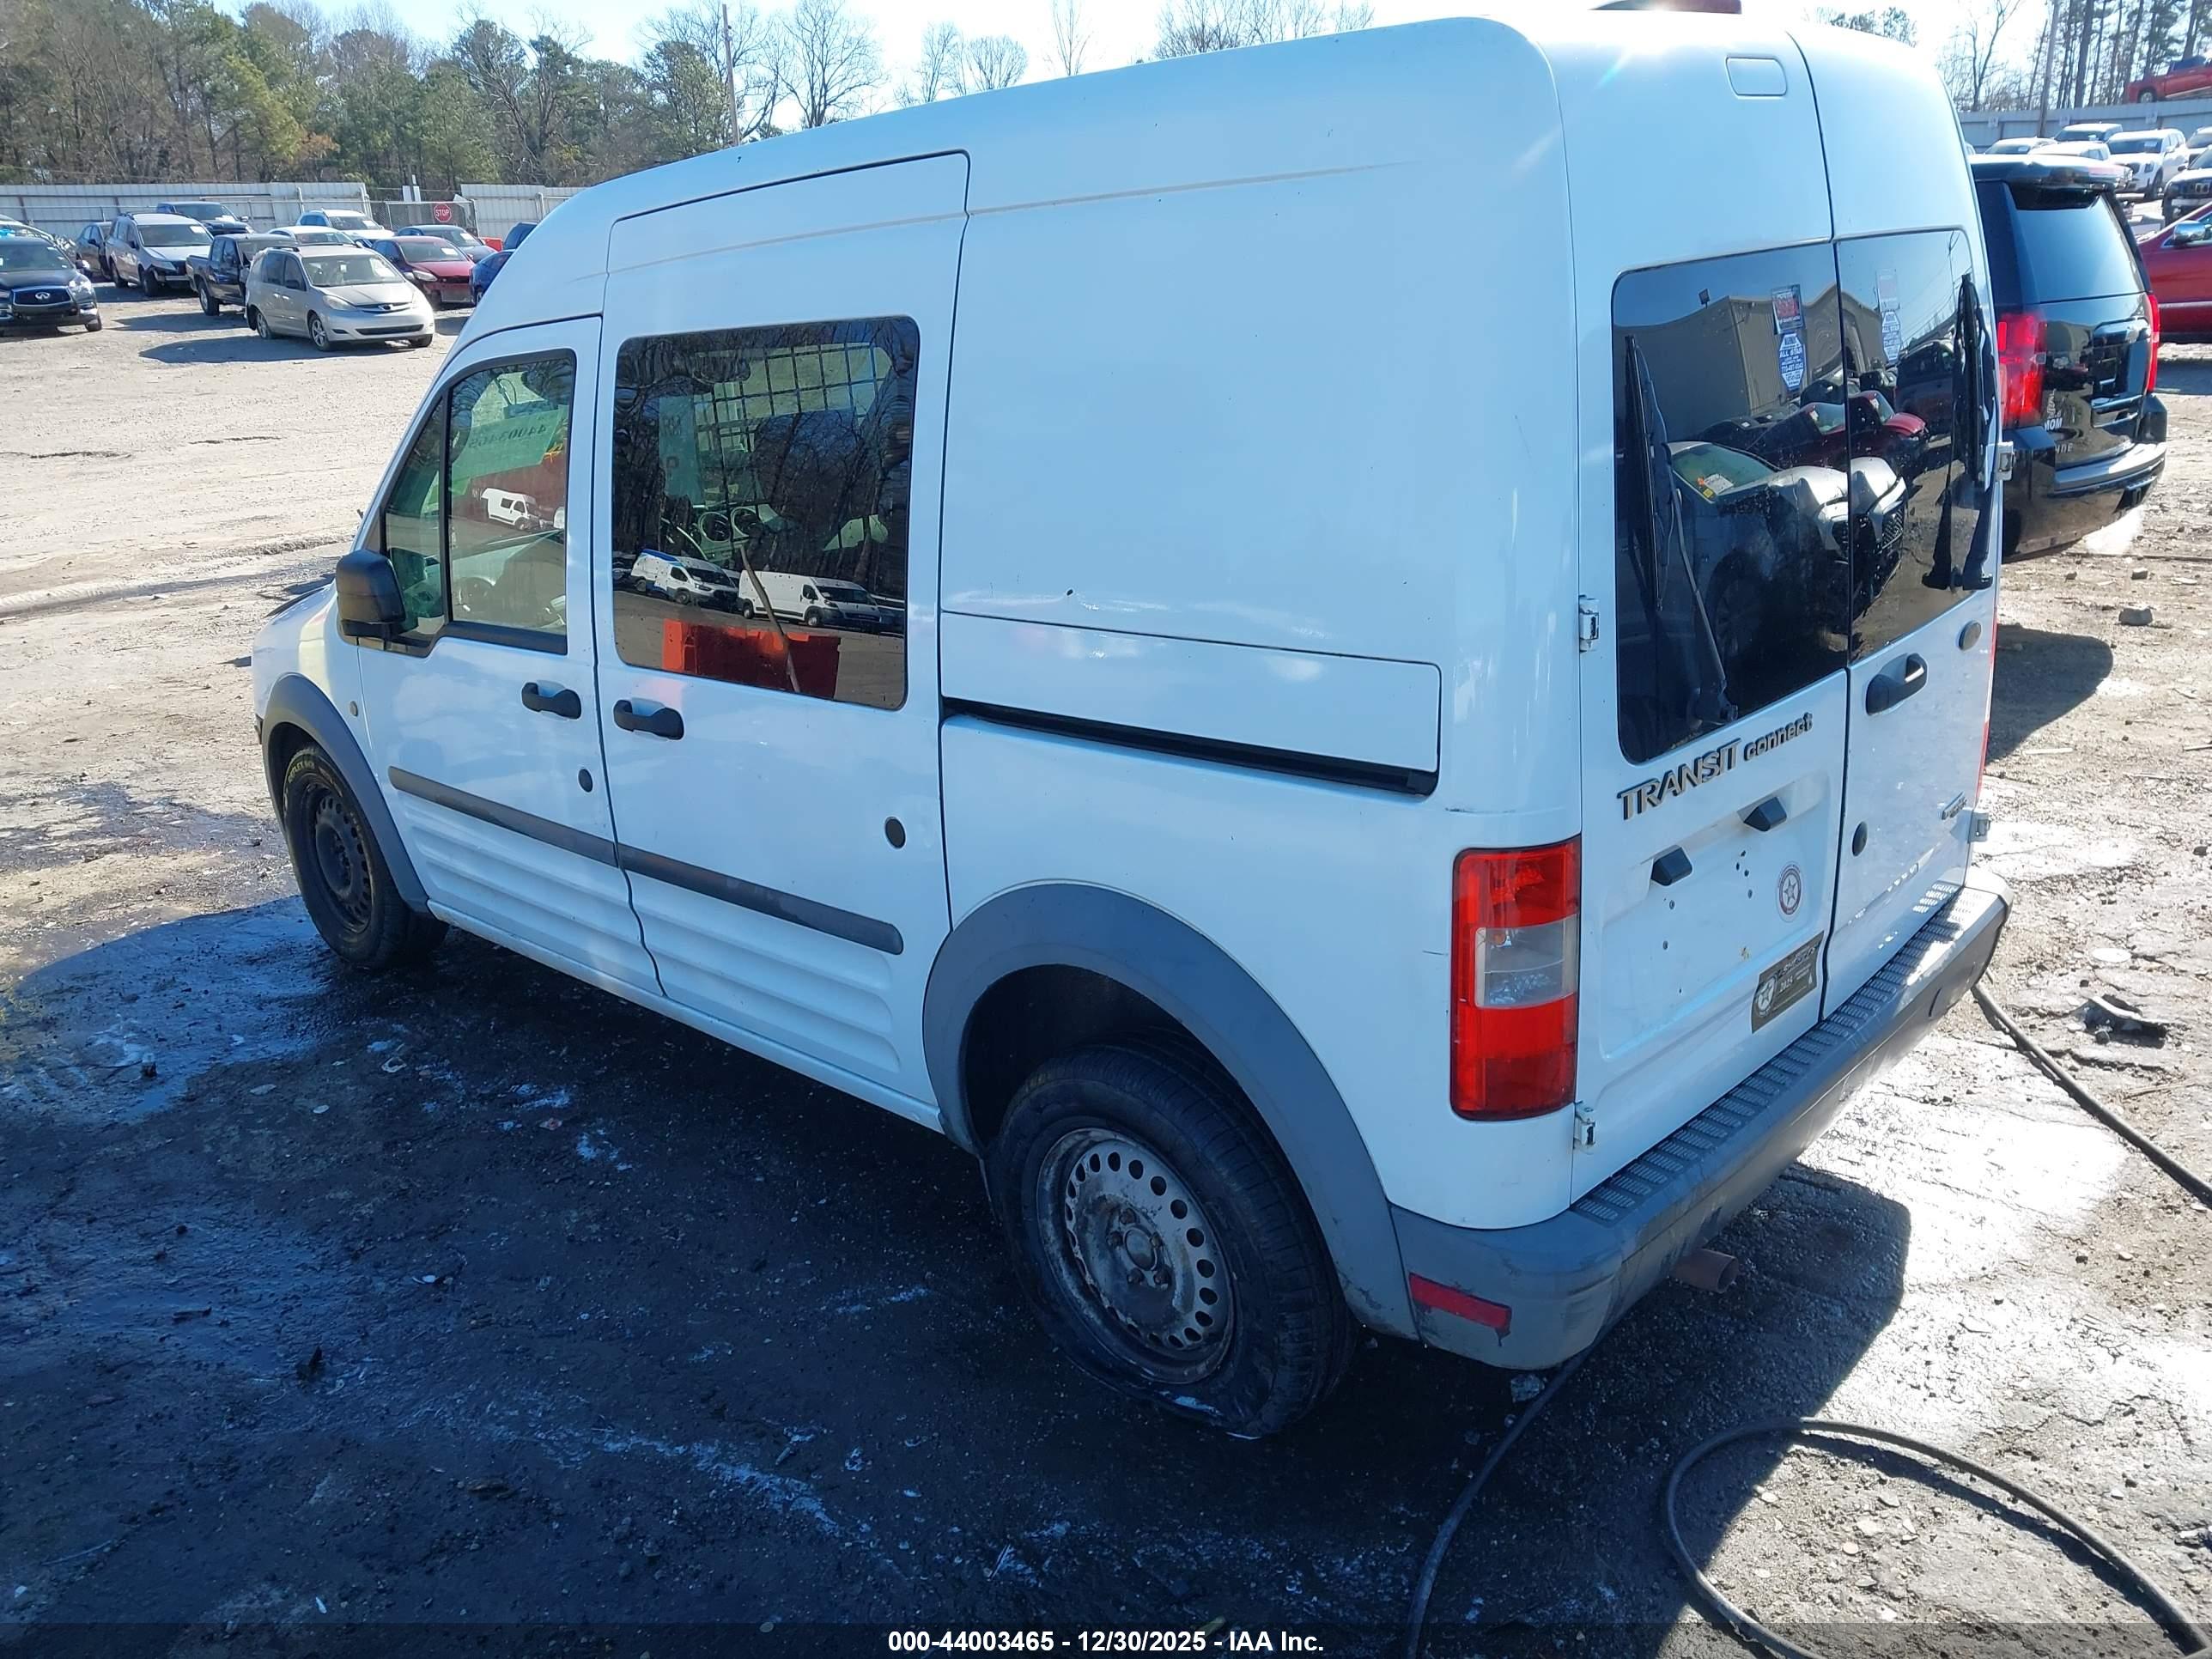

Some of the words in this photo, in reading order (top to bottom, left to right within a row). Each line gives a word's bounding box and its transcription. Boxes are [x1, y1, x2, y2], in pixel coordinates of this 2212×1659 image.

[435, 209, 450, 217] STOP
[1617, 738, 1741, 820] TRANSIT
[1744, 712, 1814, 761] connect
